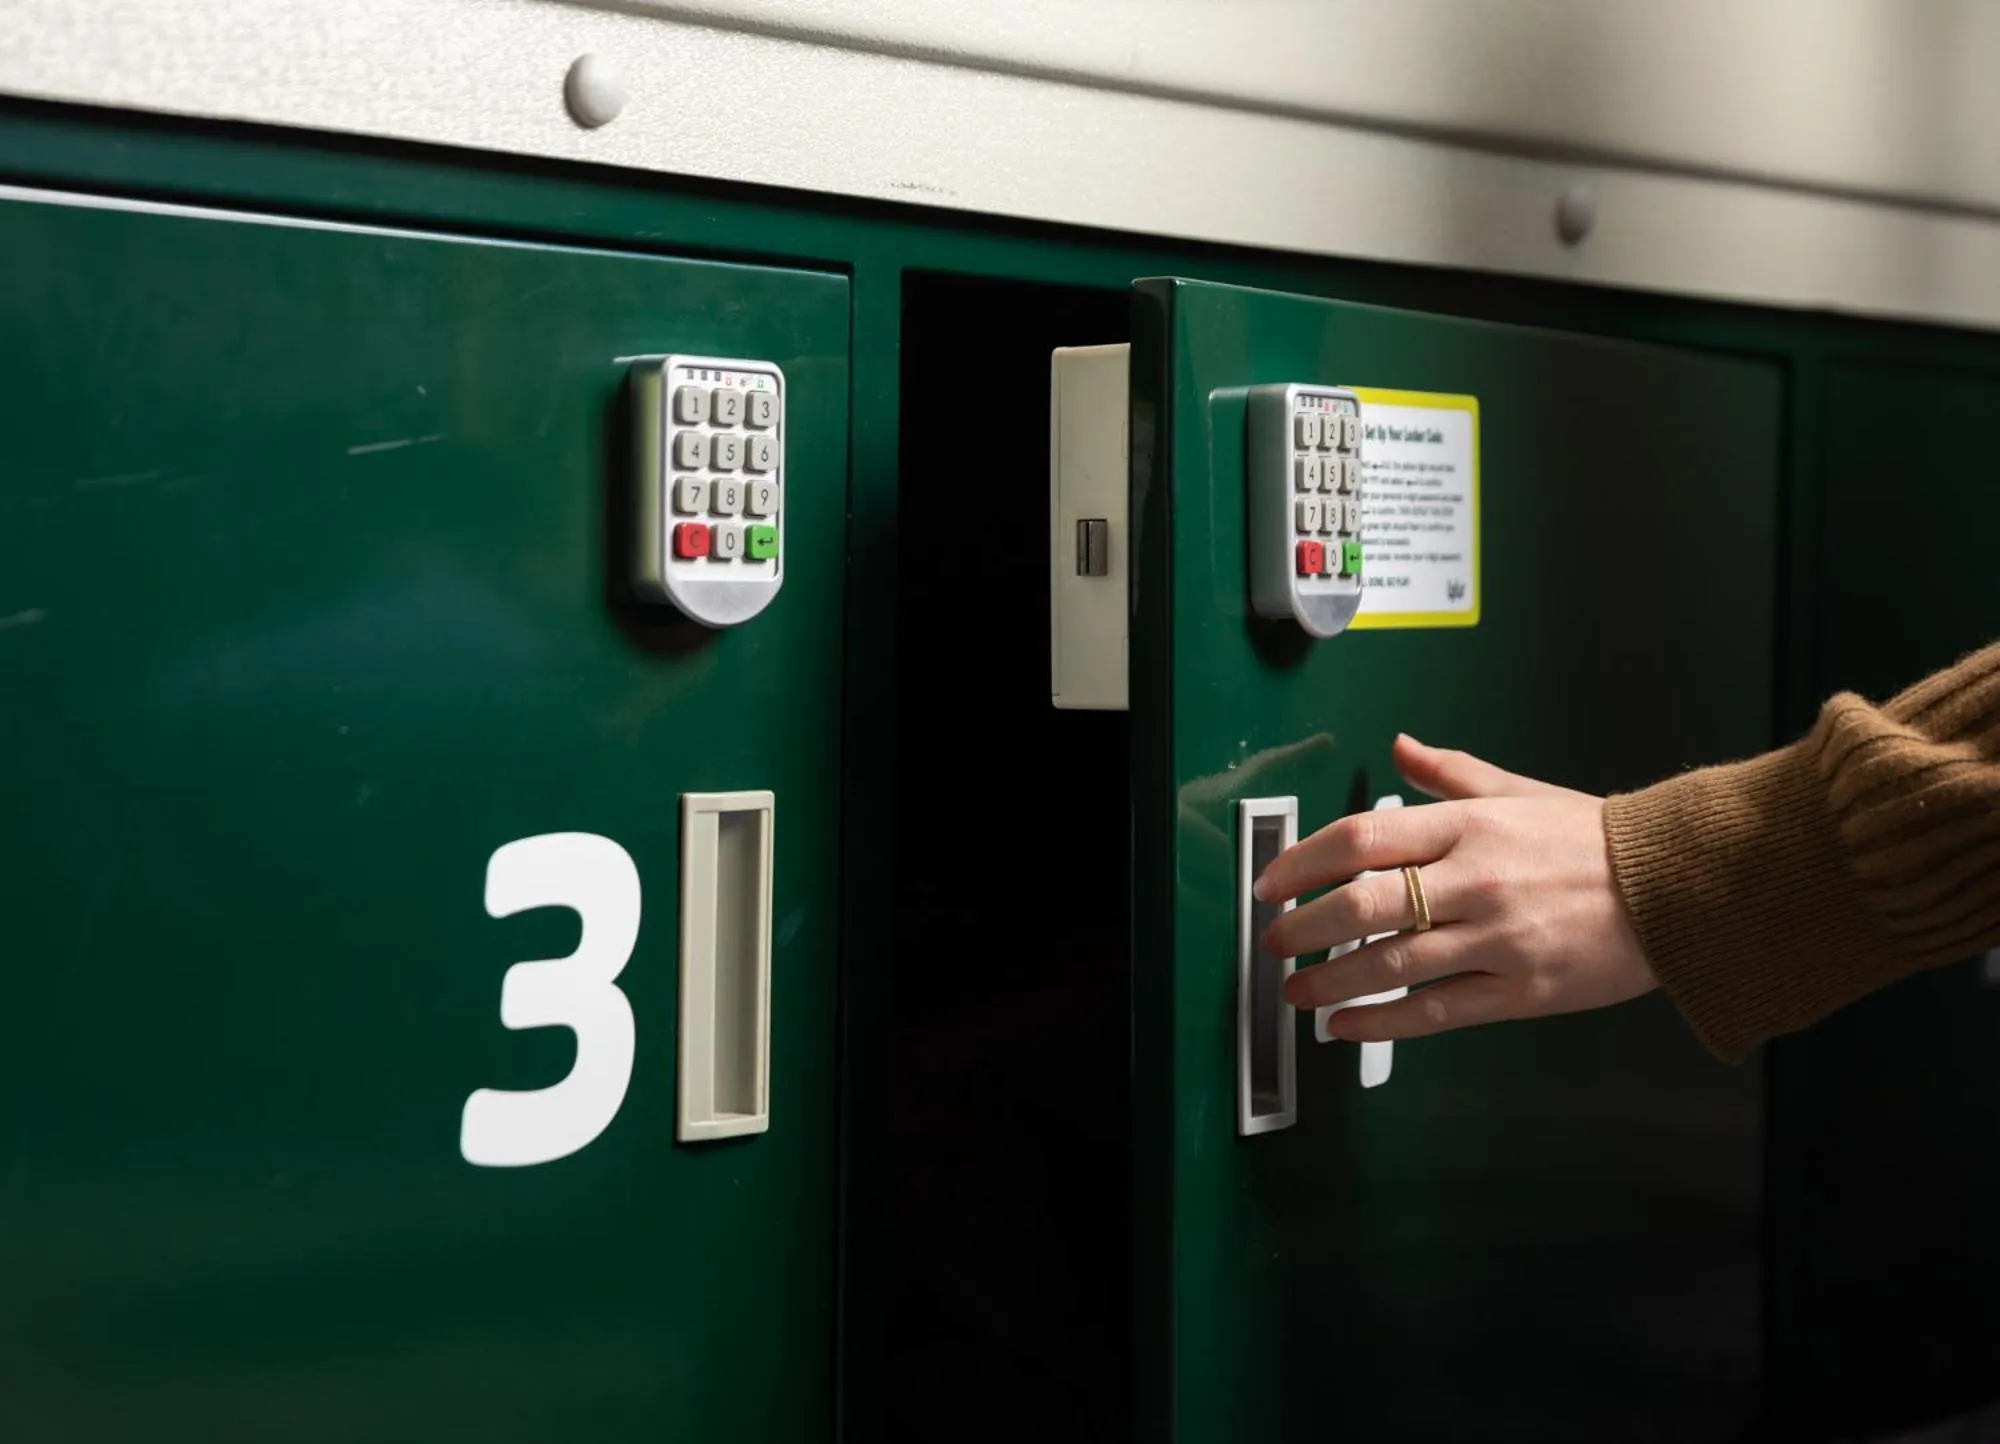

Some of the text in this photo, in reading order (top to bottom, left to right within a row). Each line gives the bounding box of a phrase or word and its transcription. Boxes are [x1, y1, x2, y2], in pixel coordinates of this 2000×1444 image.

[693, 396, 770, 419] 1 2 3
[1308, 422, 1355, 442] 1 2 3
[691, 443, 769, 463] 4 5 6
[1308, 465, 1314, 481] 4
[1330, 465, 1336, 482] 5
[1350, 467, 1356, 483] 6
[691, 486, 769, 506] 7 8 9
[1309, 506, 1316, 524] 7
[1331, 507, 1336, 525] 8
[1350, 508, 1356, 524] 9
[725, 532, 734, 550] 0
[1331, 549, 1337, 567] 0
[460, 832, 641, 1167] 3
